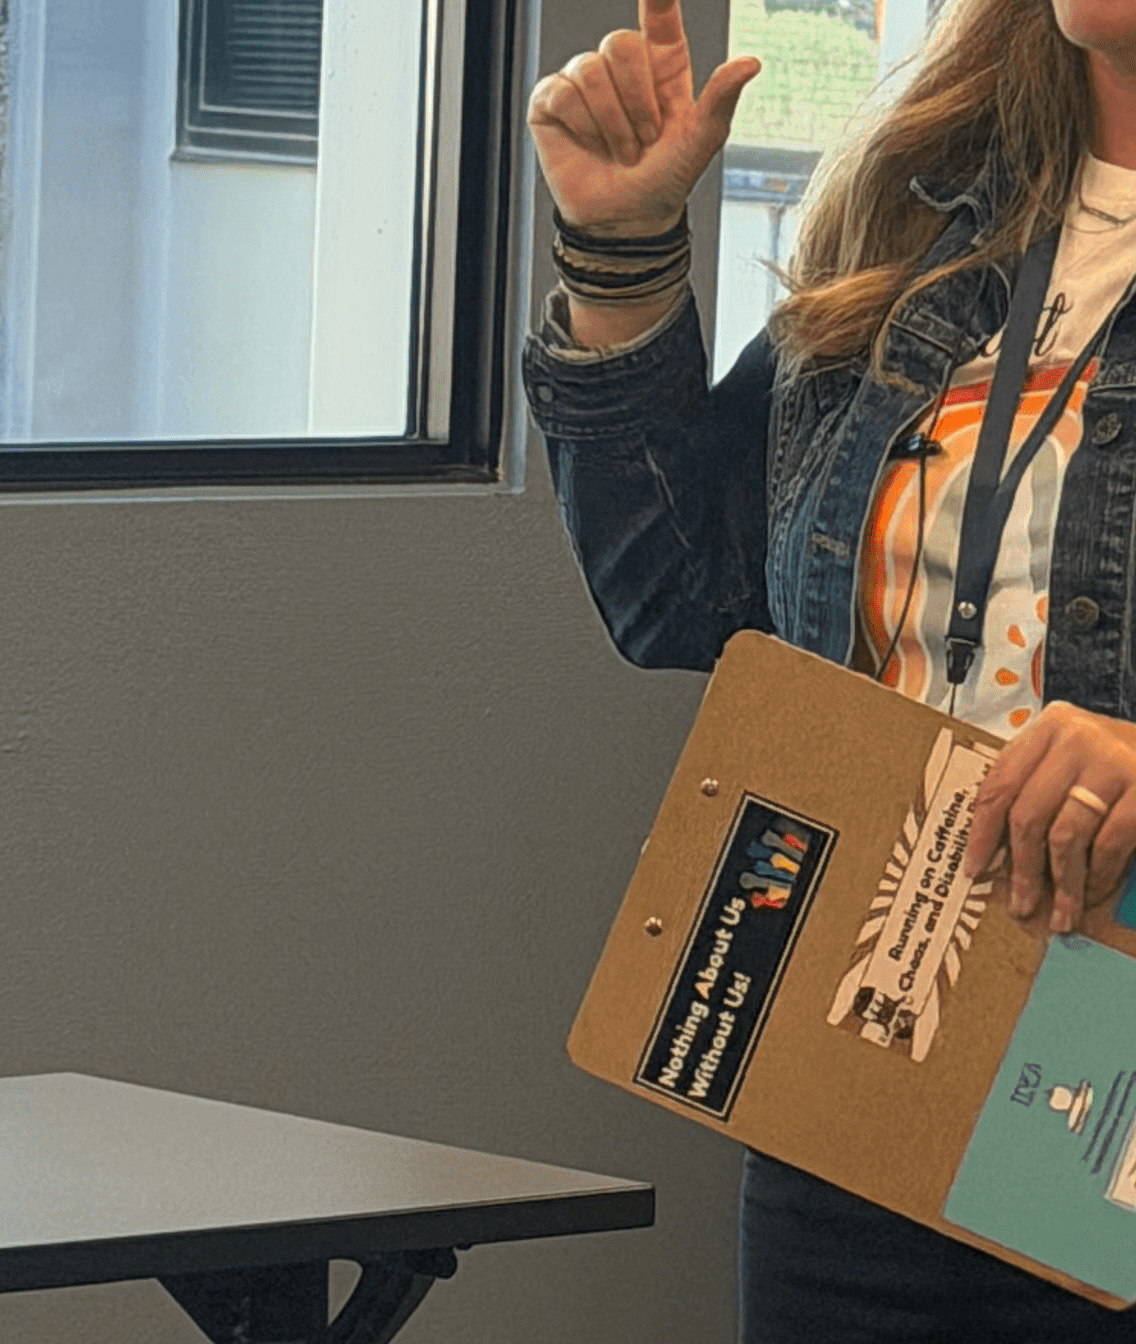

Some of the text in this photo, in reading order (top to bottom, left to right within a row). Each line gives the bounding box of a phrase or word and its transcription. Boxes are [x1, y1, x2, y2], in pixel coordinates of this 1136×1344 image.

[888, 788, 969, 961] Running on Caffeine,
[899, 937, 931, 992] Chaos,
[925, 897, 944, 933] and
[658, 897, 746, 1088] Nothing About Us
[687, 971, 751, 1098] Without Us!
